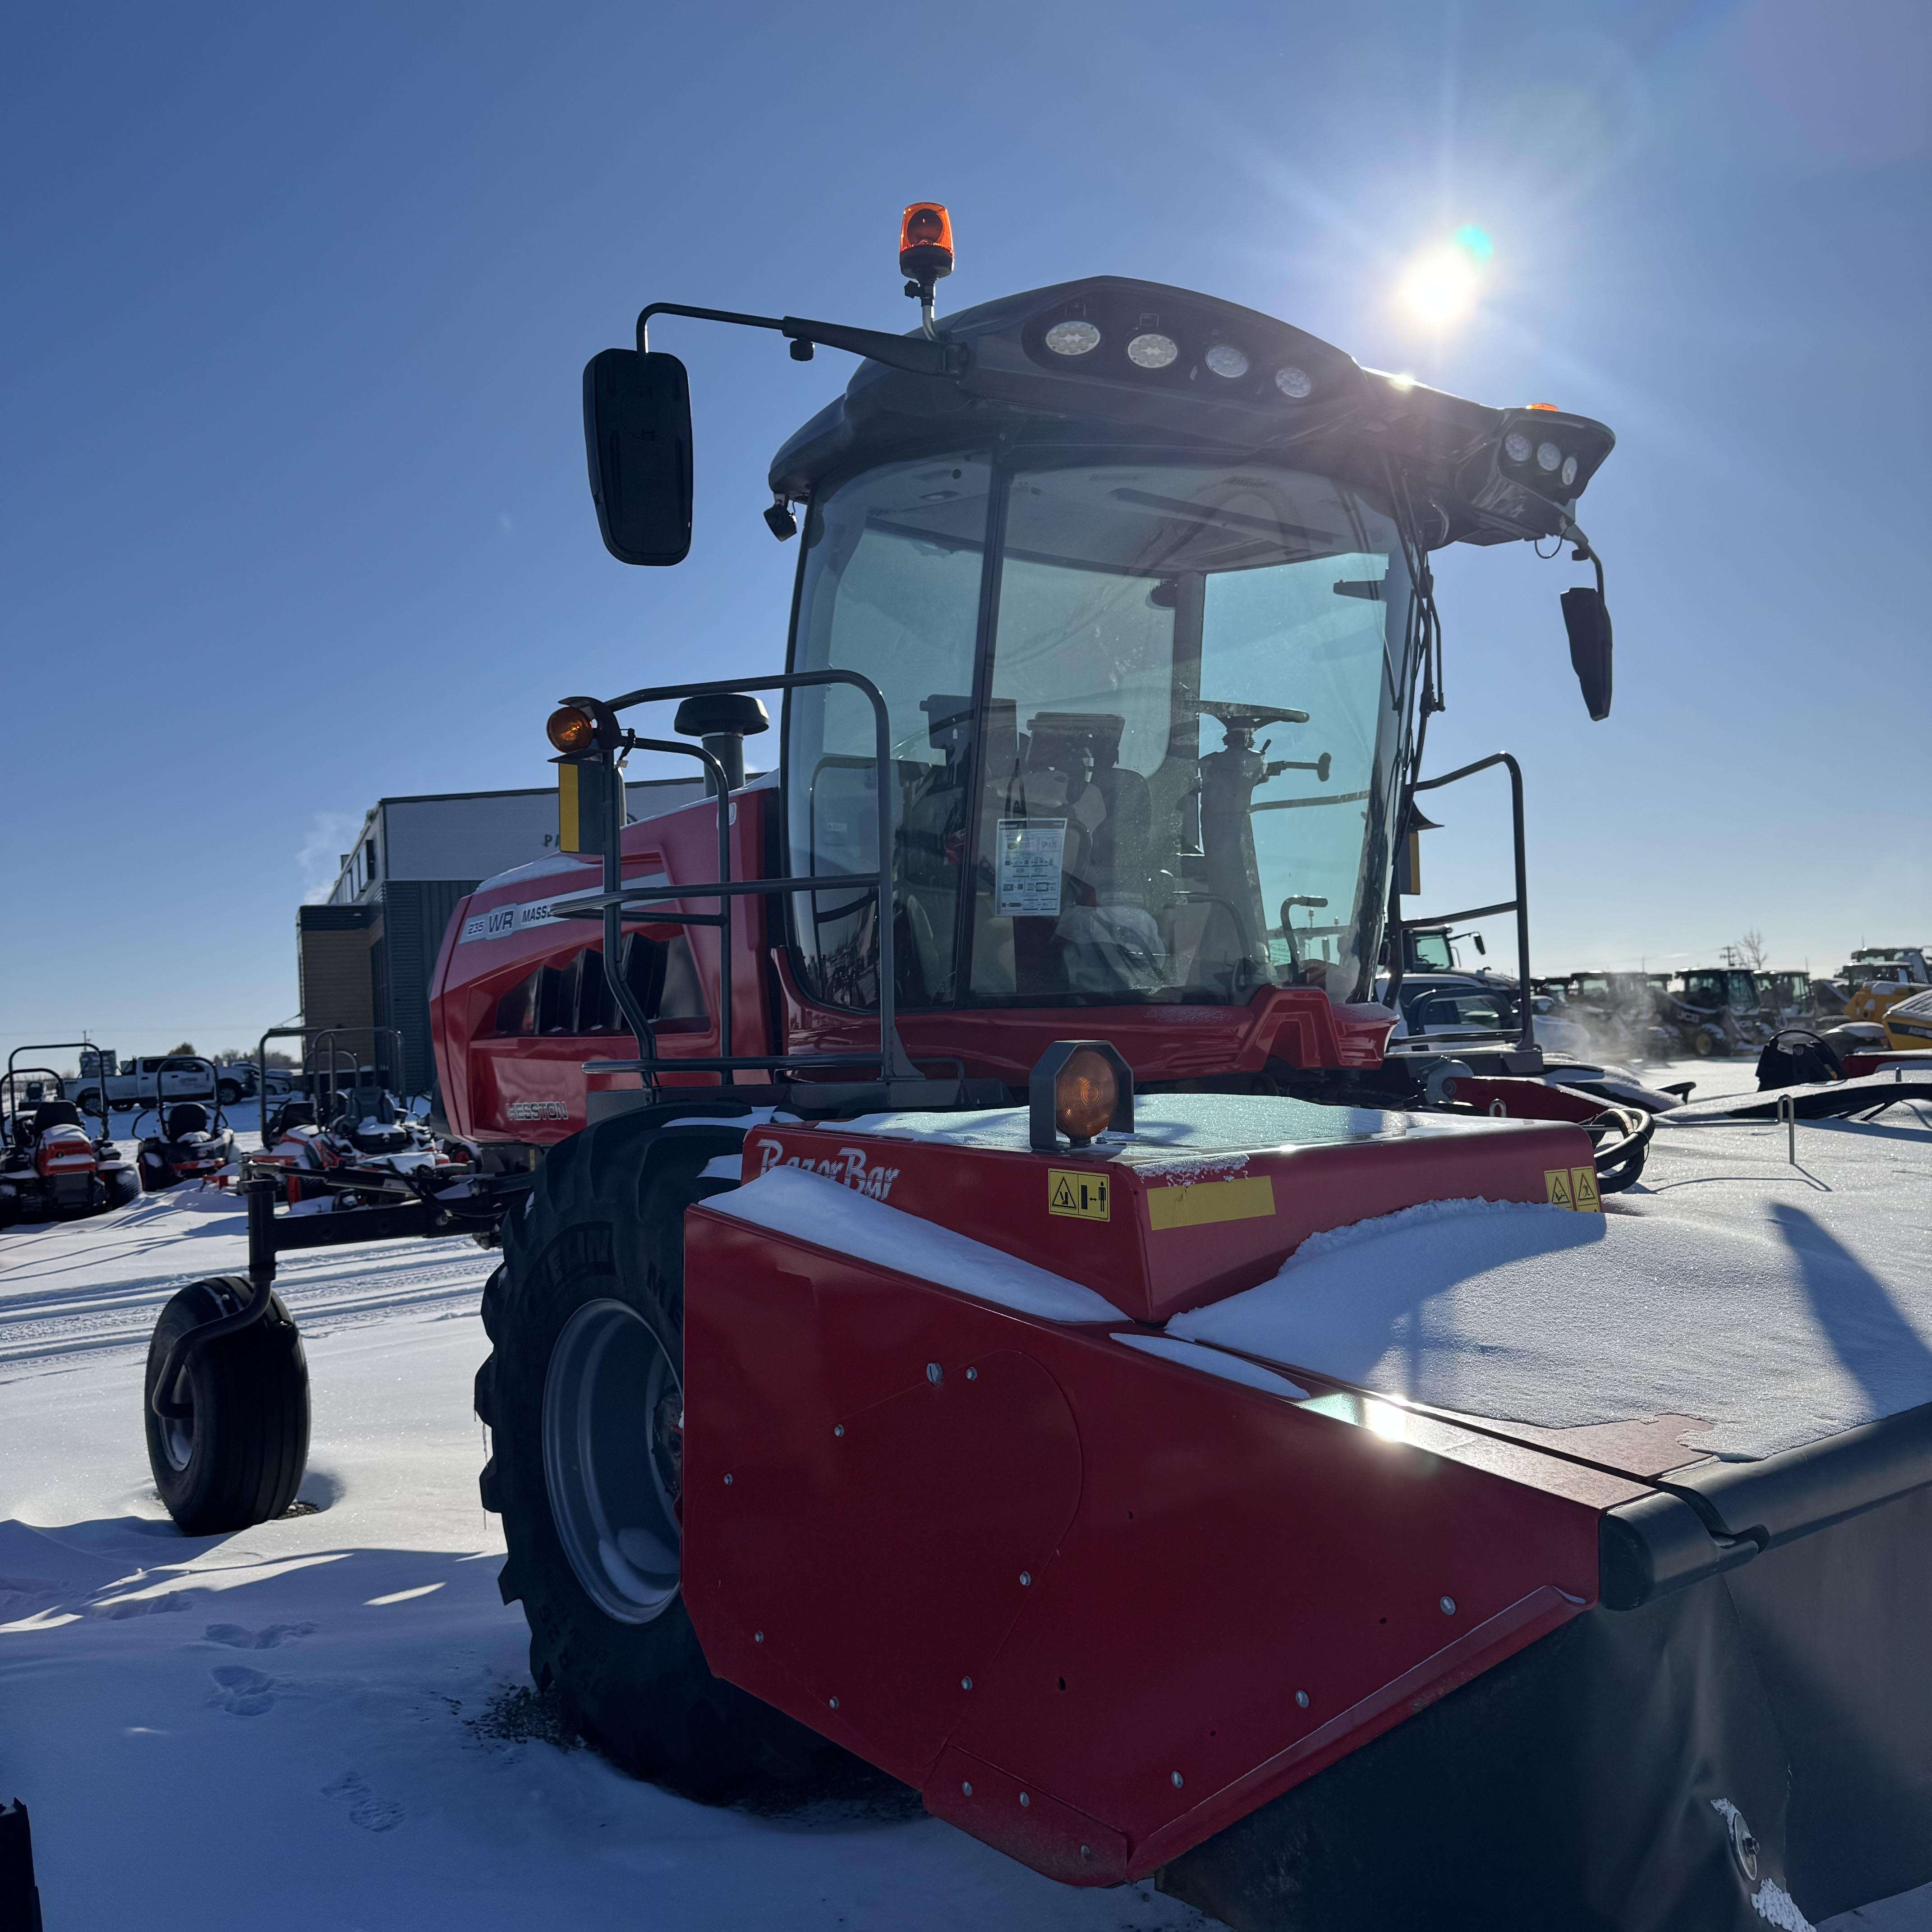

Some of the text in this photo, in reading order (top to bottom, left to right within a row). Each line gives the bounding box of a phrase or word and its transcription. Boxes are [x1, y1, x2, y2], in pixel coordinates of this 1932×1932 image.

[467, 910, 514, 935] 235 WR
[1677, 1011, 1699, 1023] JCB
[506, 1101, 568, 1121] HESSTON
[756, 1138, 900, 1201] RorBar
